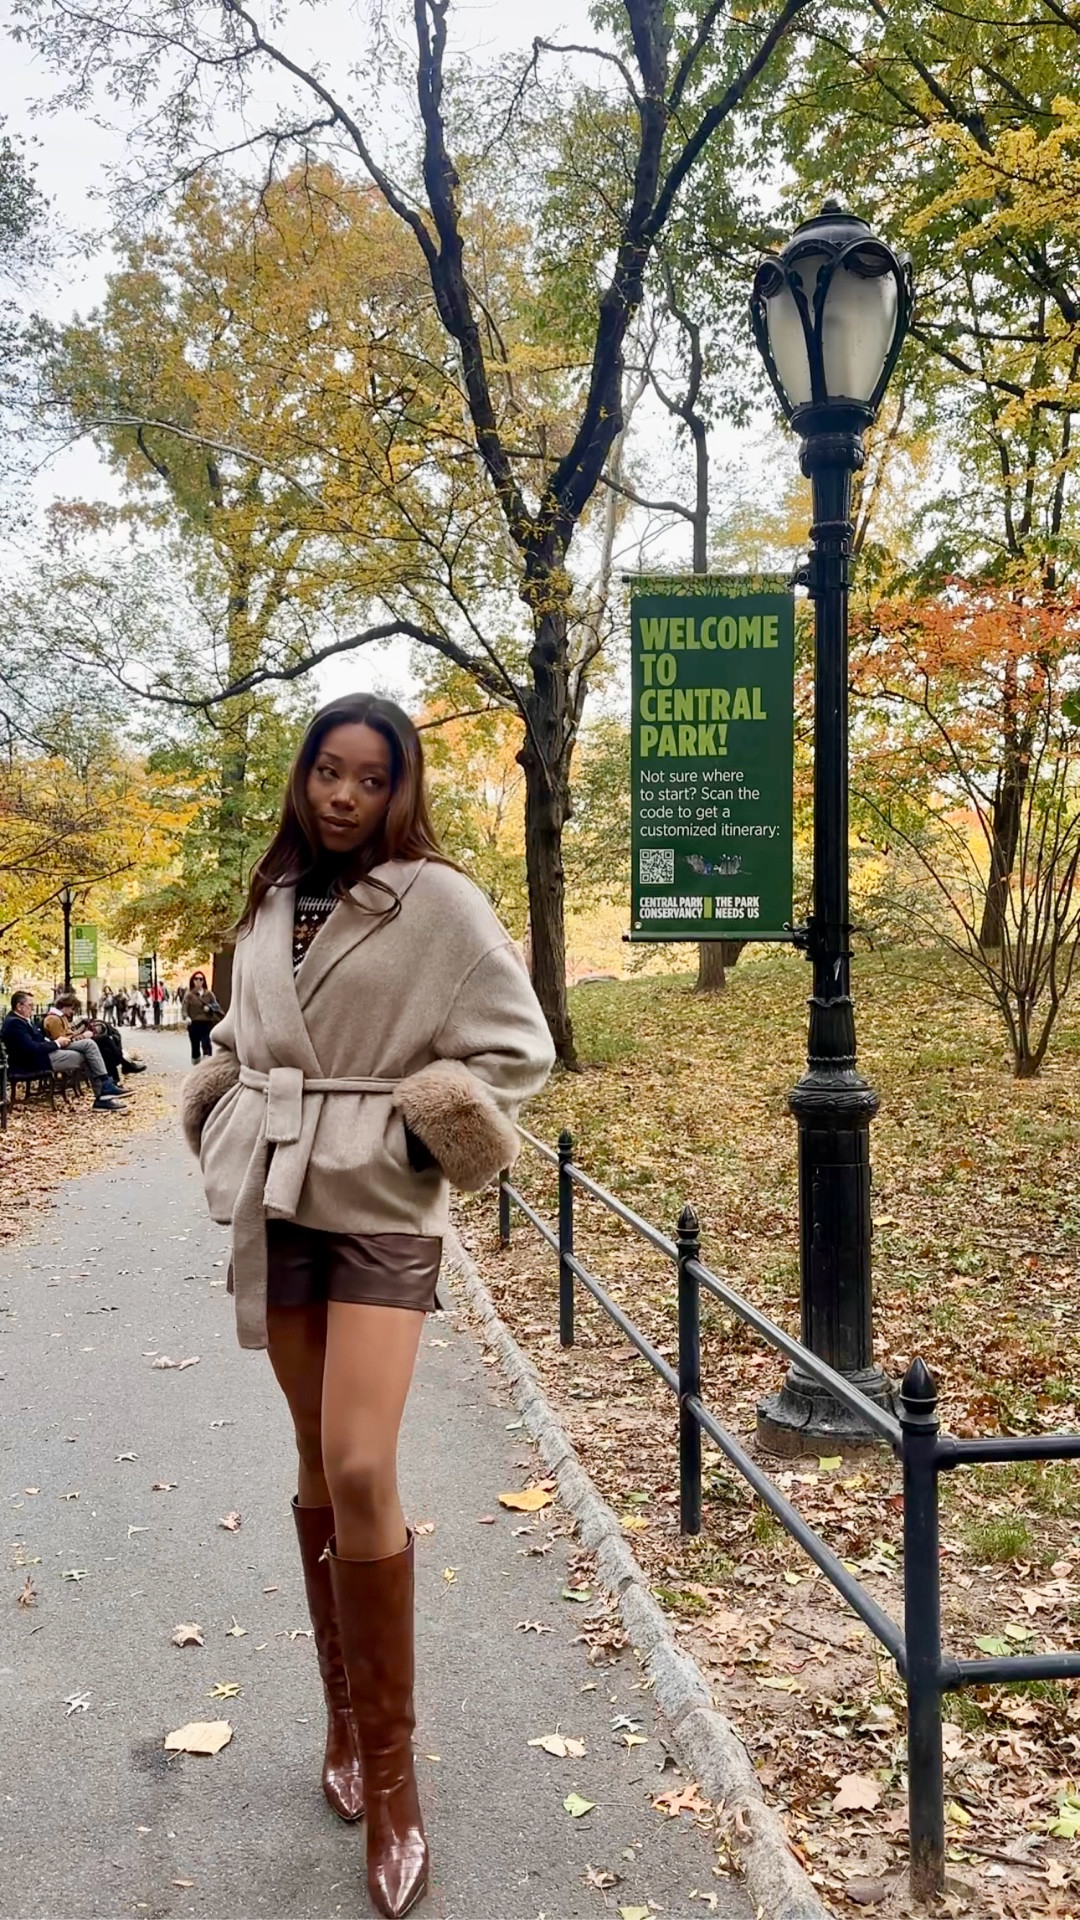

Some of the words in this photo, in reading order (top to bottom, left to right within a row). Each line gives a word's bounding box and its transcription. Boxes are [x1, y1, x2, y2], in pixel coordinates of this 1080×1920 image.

[639, 615, 779, 650] WELCOME
[639, 653, 677, 686] TO
[639, 687, 767, 722] CENTRAL
[640, 723, 728, 757] PARK!
[640, 770, 665, 783] Not
[669, 771, 698, 782] sure
[702, 769, 744, 782] where
[640, 789, 654, 801] to
[658, 787, 697, 800] start?
[701, 787, 733, 800] Scan
[738, 787, 760, 799] the
[640, 806, 673, 819] code
[678, 806, 691, 818] to
[696, 806, 718, 820] get
[722, 808, 731, 818] a
[640, 823, 716, 836] customized
[721, 824, 780, 838] itinerary:
[639, 897, 678, 908] CENTRAL
[679, 897, 703, 907] PARK
[715, 897, 733, 907] THE
[735, 896, 759, 907] PARK
[639, 908, 703, 919] CONSERVANCY
[715, 908, 745, 919] NEEDS
[747, 907, 759, 918] US
